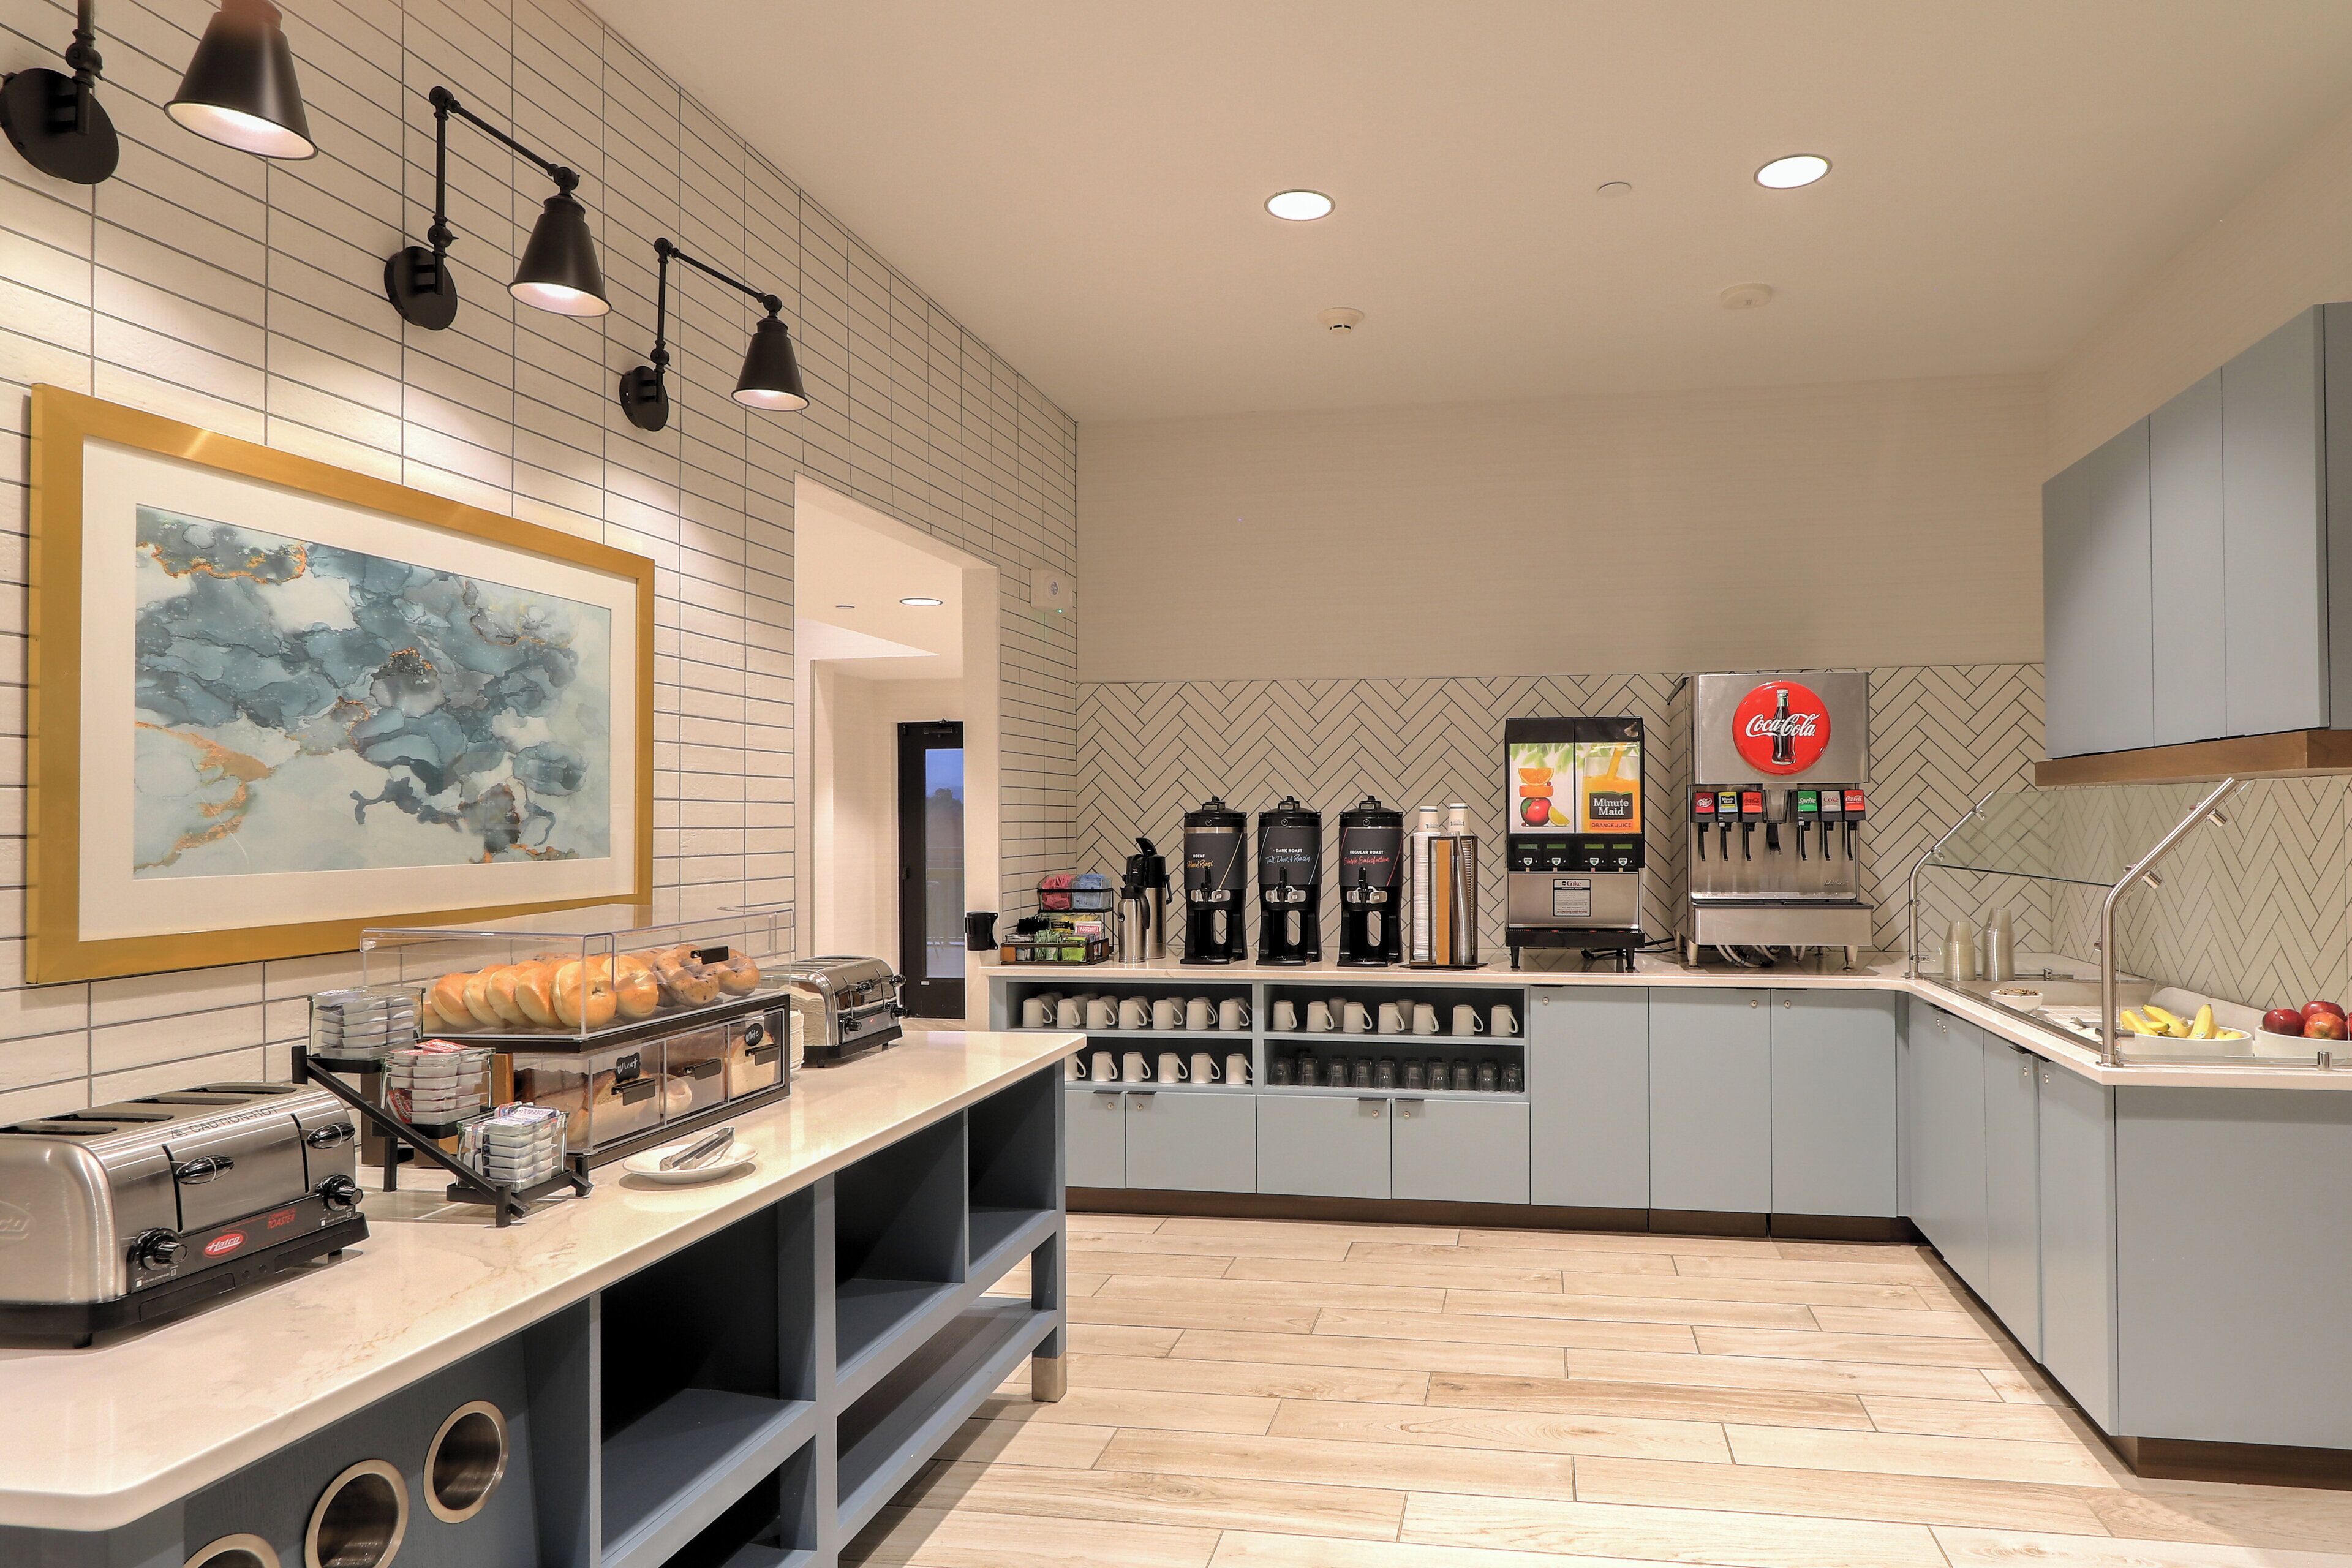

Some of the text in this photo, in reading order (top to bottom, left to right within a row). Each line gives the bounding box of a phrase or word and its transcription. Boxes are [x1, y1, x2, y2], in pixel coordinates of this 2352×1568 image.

[1746, 714, 1820, 737] Coca-Cola
[1593, 798, 1629, 807] Minute
[1598, 807, 1624, 816] Maid
[617, 1058, 638, 1074] Wheat
[267, 1214, 295, 1229] TOASTER
[206, 1236, 241, 1252] Hatco
